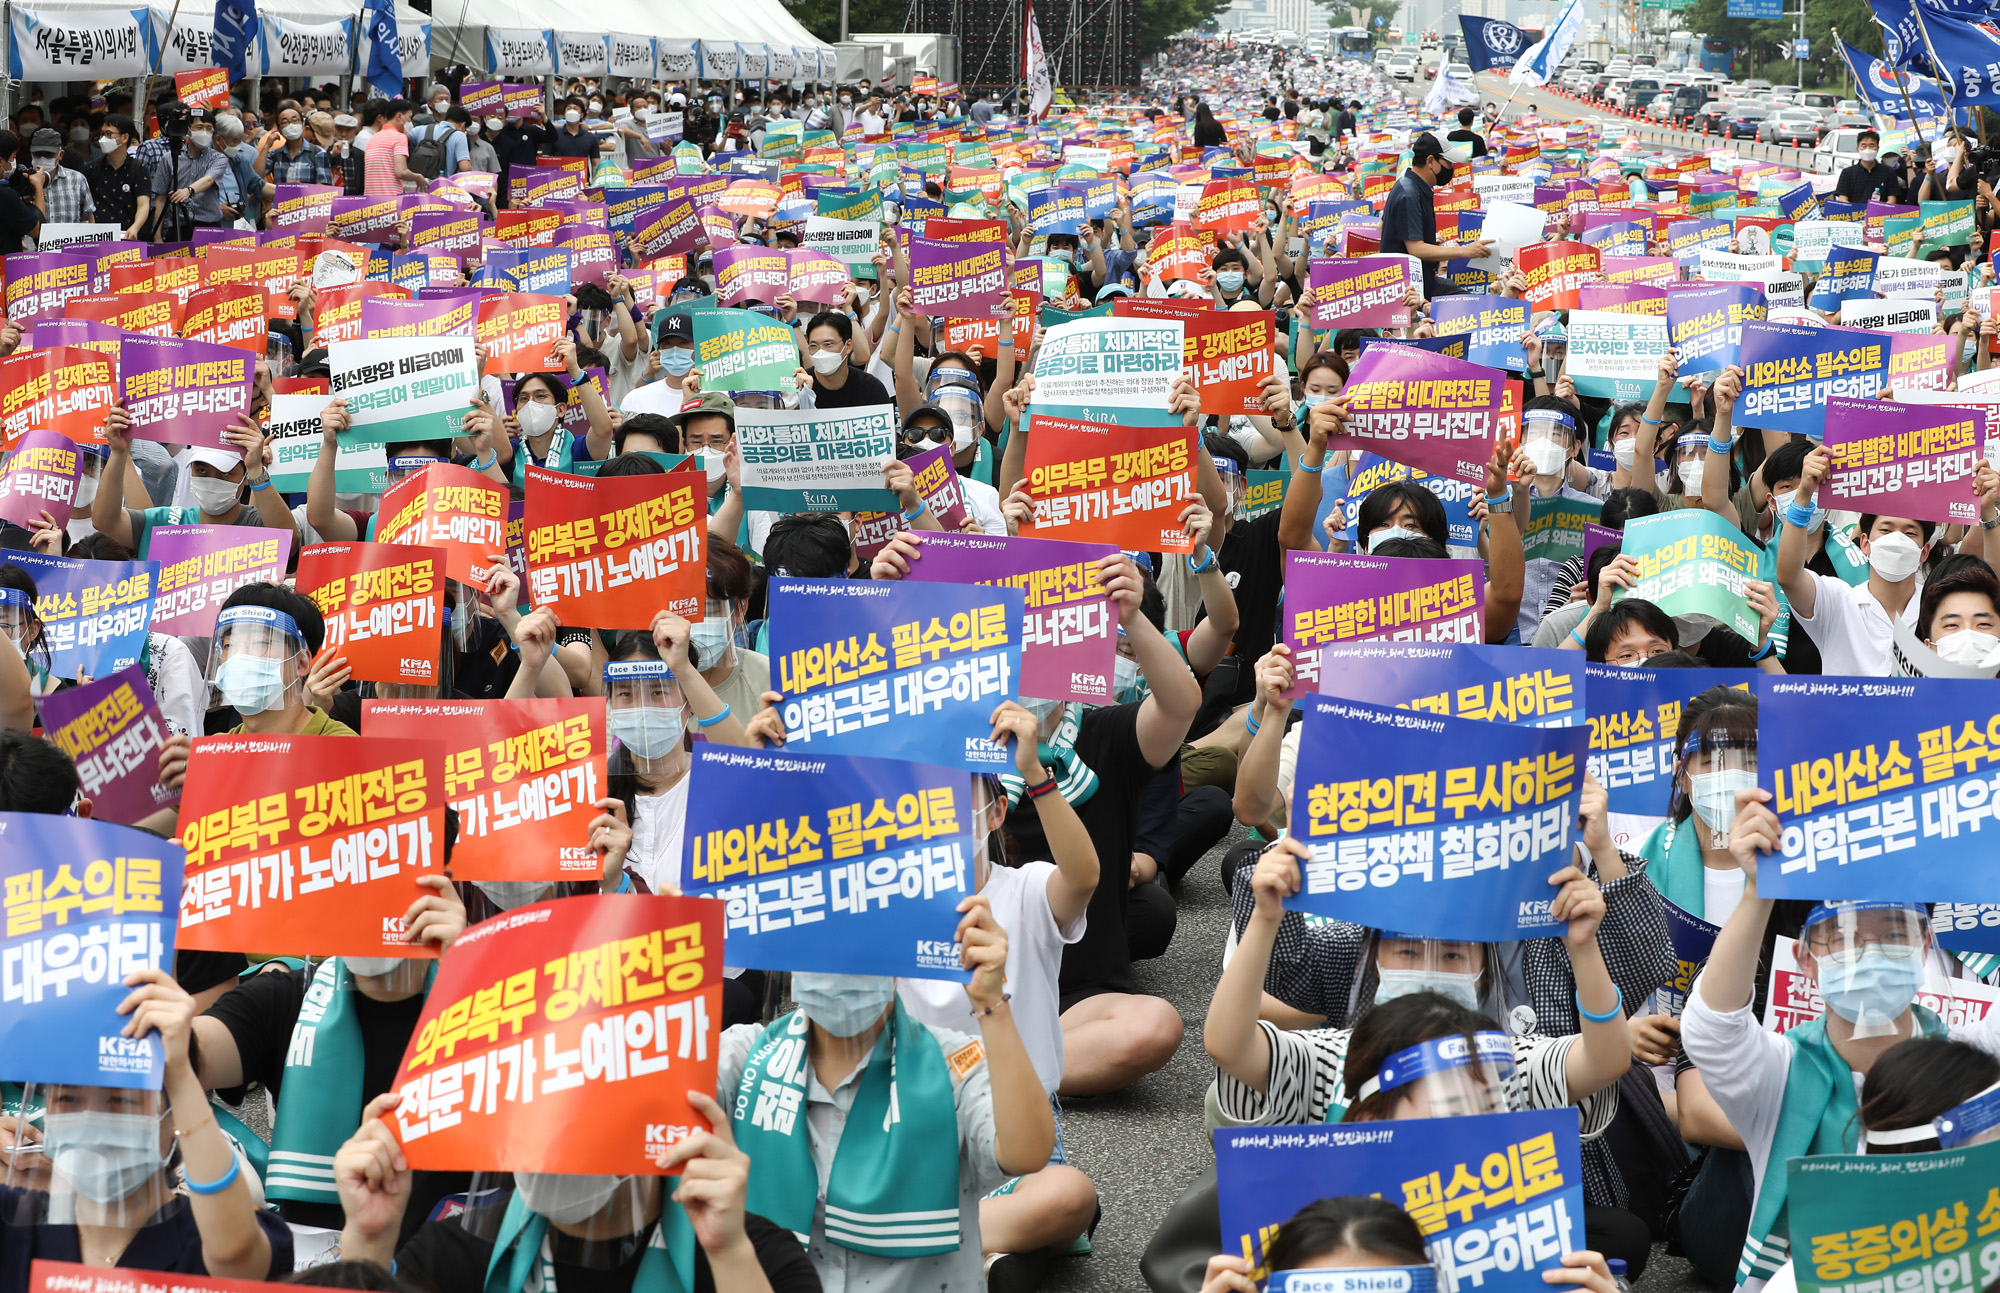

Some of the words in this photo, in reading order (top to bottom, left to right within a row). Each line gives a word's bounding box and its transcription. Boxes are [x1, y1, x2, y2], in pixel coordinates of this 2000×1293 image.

[36, 26, 137, 64] 서울특별시의사회
[277, 198, 303, 213] 무분별한
[334, 212, 361, 226] 무분별한
[362, 200, 397, 216] 비대면진료
[849, 192, 879, 218] 잊었는가
[1031, 203, 1056, 219] 내외산소
[1058, 197, 1083, 210] 필수의료
[1032, 215, 1058, 230] 의학근본
[1060, 206, 1084, 220] 대우하라
[1924, 215, 1949, 228] 서남의대
[1950, 204, 1974, 221] 잊었는가
[413, 227, 438, 246] 무분별한
[440, 217, 478, 238] 비대면진료
[156, 264, 199, 291] 강제전공
[913, 264, 953, 284] 무분별한
[954, 250, 1002, 277] 비대면진료
[1316, 281, 1354, 301] 무분별한
[1356, 264, 1403, 289] 비대면진료
[1832, 275, 1870, 294] 대우하라
[912, 281, 959, 306] 국민건강
[962, 269, 1004, 296] 무너진다
[1318, 299, 1360, 320] 국민건강
[1363, 283, 1406, 308] 무너진다
[1525, 281, 1563, 302] 우선순위
[1434, 316, 1477, 337] 내외산소
[1480, 306, 1525, 328] 필수의료
[1672, 310, 1726, 343] 내외산소
[1728, 300, 1768, 325] 필수의료
[1888, 309, 1930, 325] 비급여에
[700, 332, 743, 362] 중증외상
[745, 321, 793, 345] 소아외과
[1039, 330, 1099, 358] 대화통해
[1104, 327, 1180, 352] 체계적인
[1202, 320, 1267, 354] 강제전공
[125, 372, 172, 401] 무분별한
[176, 357, 245, 392] 비대면진료
[332, 360, 395, 392] 최신항암
[398, 347, 464, 376] 비급여에
[1034, 352, 1098, 378] 공공의료
[1103, 350, 1180, 376] 마련하라
[1041, 380, 1070, 388] 의료계와의
[1085, 379, 1098, 387] 없이
[1126, 378, 1139, 386] 의대
[1202, 347, 1270, 385] 노예인가
[1746, 355, 1813, 389] 내외산소
[1816, 344, 1882, 378] 필수의료
[3, 377, 51, 416] 의무복무
[54, 360, 110, 389] 강제전공
[1069, 387, 1139, 396] 보건의료정책심의위원회
[1745, 386, 1811, 417] 의학근본
[1814, 374, 1883, 407] 대우하라
[3, 402, 55, 440] 전문가가
[58, 385, 113, 417] 노예인가
[738, 423, 811, 446] 대화통해
[816, 412, 891, 442] 체계적인
[396, 458, 414, 467] Face
[417, 457, 447, 467] Shield
[742, 445, 812, 465] 공공의료
[816, 433, 893, 461] 마련하라
[1832, 437, 1897, 469] 무분별한
[1898, 419, 1976, 456] 비대면진료
[761, 474, 785, 482] 당사자와
[1031, 459, 1105, 496] 의무복무
[1110, 438, 1189, 482] 강제전공
[1456, 460, 1484, 471] KMA
[1831, 464, 1903, 499] 국민건강
[1905, 449, 1977, 487] 무너진다
[378, 496, 428, 544] 의무복무
[432, 486, 502, 513] 강제전공
[1035, 492, 1107, 529] 전문가가
[1112, 473, 1192, 511] 노예인가
[1950, 502, 1976, 513] KMA
[431, 514, 503, 547] 노예인가
[529, 523, 598, 564] 의무복무
[603, 485, 695, 550] 강제전공
[204, 539, 279, 577] 비대면진료
[81, 573, 150, 612] 필수의료
[349, 559, 434, 606] 강제전공
[1624, 568, 1696, 600] 의학교육
[220, 611, 239, 622] Face
[242, 609, 274, 620] Shield
[348, 598, 436, 643] 노예인가
[669, 598, 698, 611] KMA
[1295, 602, 1378, 645] 무분별한
[1380, 573, 1477, 629] 비대면진료
[79, 606, 147, 645] 대우하라
[1021, 601, 1109, 651] 무너진다
[609, 664, 629, 675] Face
[632, 662, 664, 673] Shield
[780, 633, 888, 696] 내외산소
[892, 603, 1009, 682] 필수의료
[784, 687, 891, 743] 의학근본
[894, 651, 1011, 717] 대우하라
[1071, 673, 1107, 686] KMA
[1455, 668, 1573, 725] 무시하는
[1774, 730, 1914, 816] 내외산소
[1308, 772, 1437, 837] 현장의견
[1442, 751, 1575, 820] 무시하는
[183, 792, 291, 866] 의무복무
[295, 765, 427, 838] 강제전공
[559, 847, 598, 859] KMA
[693, 817, 824, 884] 내외산소
[827, 786, 960, 855] 필수의료
[1305, 822, 1434, 896] 불통정책
[1438, 800, 1572, 880] 철회하라
[1780, 802, 1917, 876] 의학근본
[180, 849, 295, 929] 전문가가
[299, 815, 433, 894] 노예인가
[830, 842, 966, 913] 대우하라
[4, 857, 164, 937] 필수의료
[2, 921, 164, 1007] 대우하라
[419, 965, 538, 1072] 의무복무
[544, 921, 705, 1013] 강제전공
[98, 1056, 152, 1068] 대한의사협회
[99, 1036, 151, 1057] KMA
[394, 1036, 536, 1143] 전문가가
[540, 995, 708, 1095] 노예인가
[739, 1067, 758, 1093] NO
[733, 1093, 749, 1121] DO
[1401, 1130, 1565, 1236] 필수의료
[1811, 1201, 1970, 1281] 중증외상
[1292, 1277, 1335, 1293] Face
[1344, 1275, 1404, 1292] Shield
